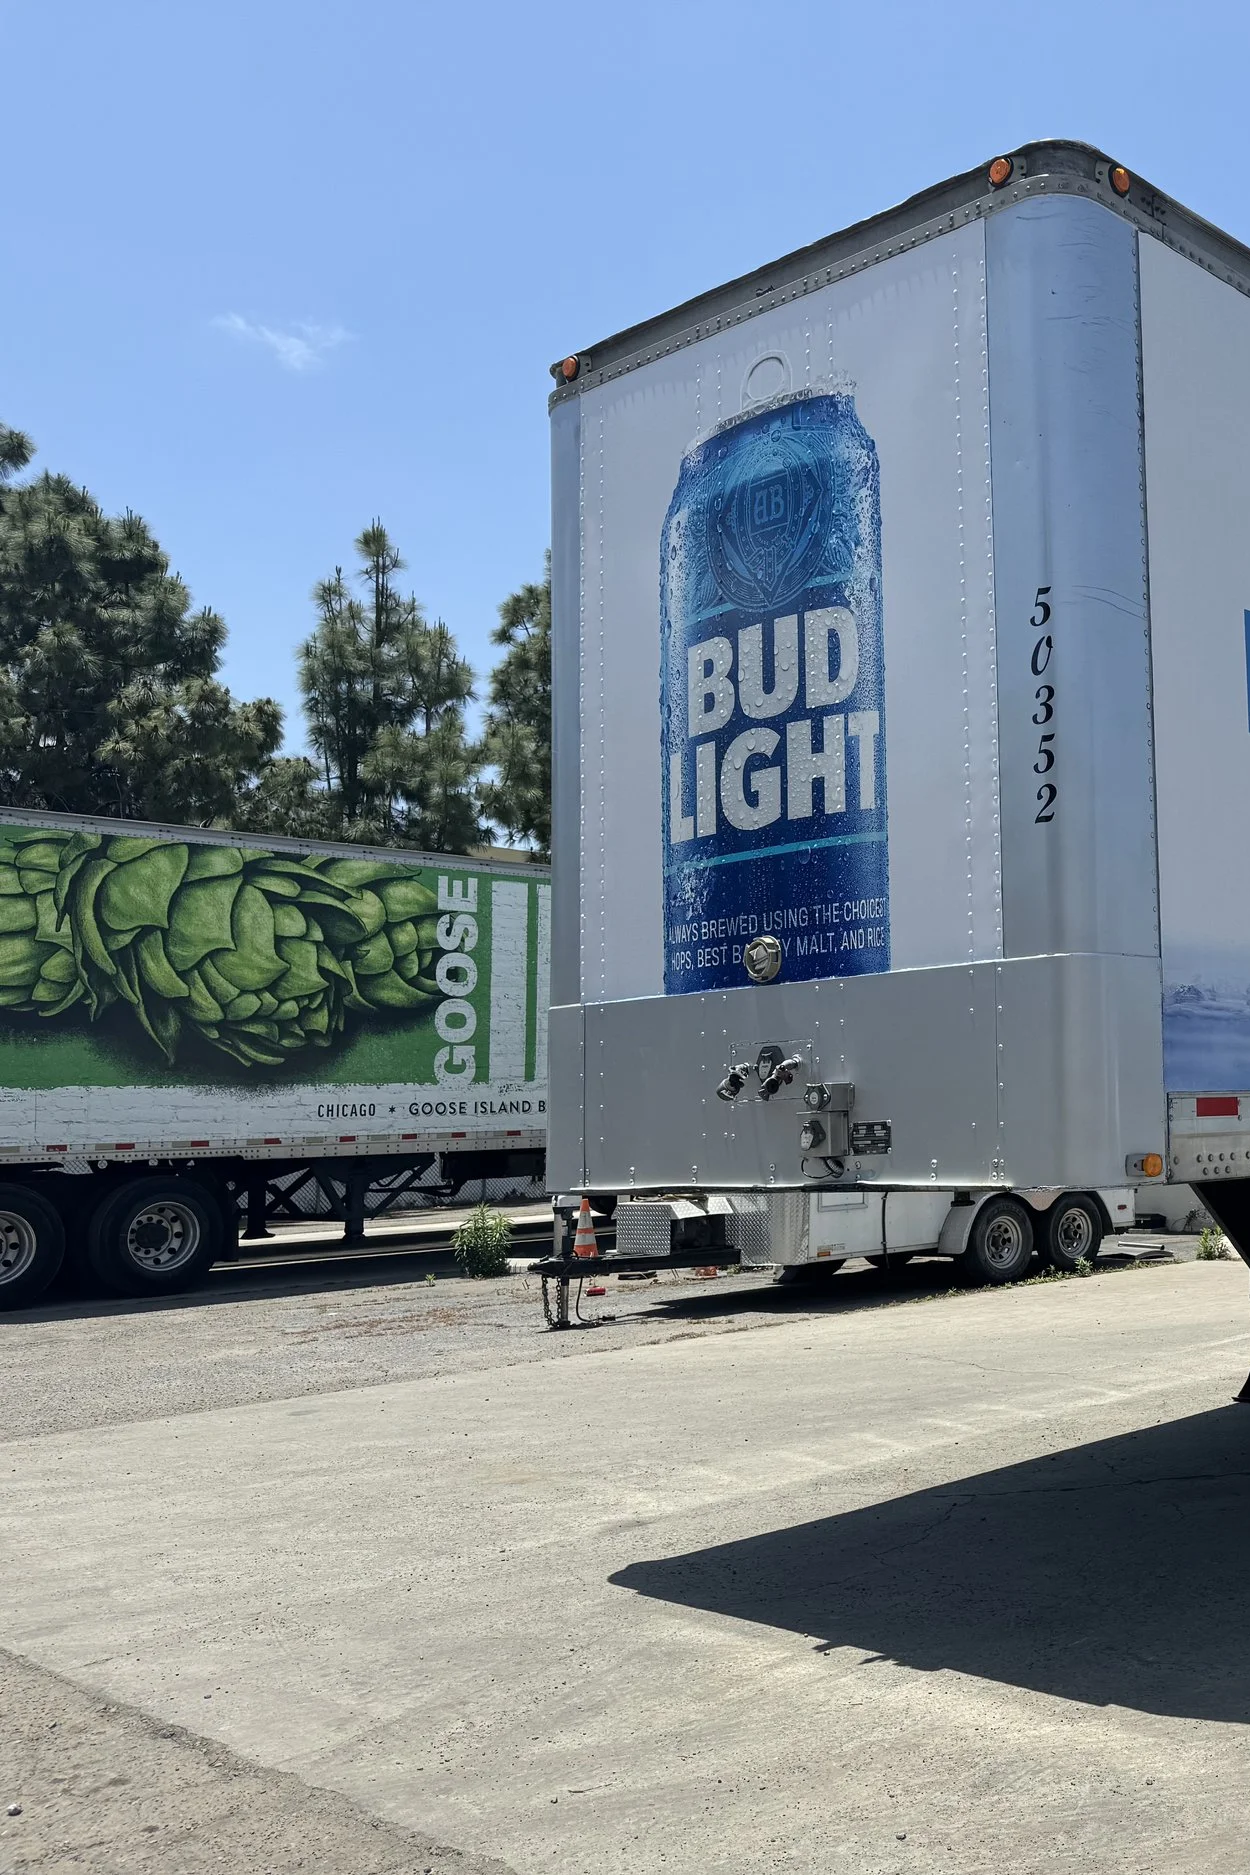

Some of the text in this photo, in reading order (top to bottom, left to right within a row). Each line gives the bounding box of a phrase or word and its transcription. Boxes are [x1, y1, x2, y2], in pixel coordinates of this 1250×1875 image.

[687, 605, 860, 738] BUD
[1029, 586, 1058, 824] 50352
[670, 710, 880, 844] LIGHT
[433, 875, 479, 1087] GOOSE
[671, 946, 694, 971] HOPS,
[697, 945, 728, 968] BEST
[796, 932, 838, 957] MALT,
[841, 929, 865, 950] AND
[867, 926, 885, 948] RICE
[701, 914, 758, 940] BREWED
[763, 906, 809, 931] USING
[813, 903, 840, 925] THE
[843, 897, 886, 921] CHOICEST
[317, 1100, 547, 1118] CHICAGO GOOSE ISLAND B
